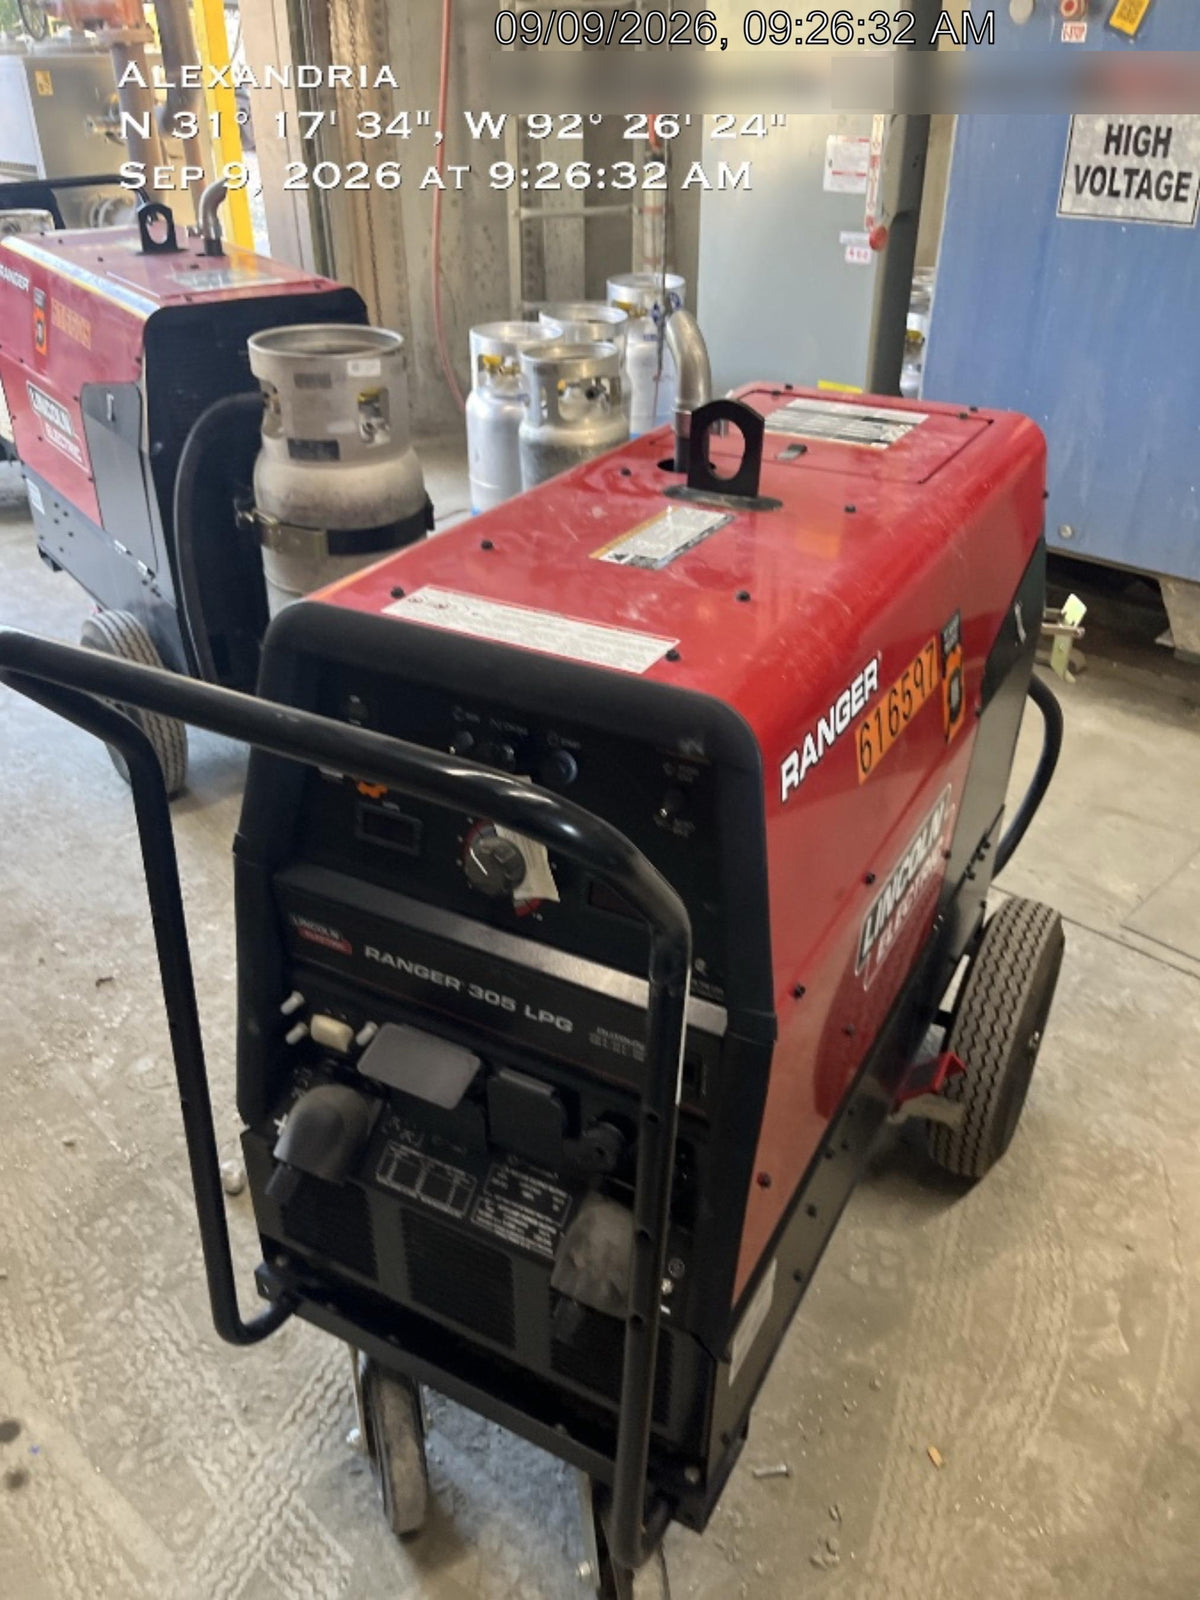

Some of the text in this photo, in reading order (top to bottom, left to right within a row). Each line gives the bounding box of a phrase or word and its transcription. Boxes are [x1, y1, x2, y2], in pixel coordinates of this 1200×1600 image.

[1074, 165, 1193, 203] VOLTAGE
[1104, 123, 1173, 159] HIGH
[779, 658, 879, 802] RANGER
[859, 644, 937, 775] 616597
[364, 945, 574, 1033] RANGER 305 LPG
